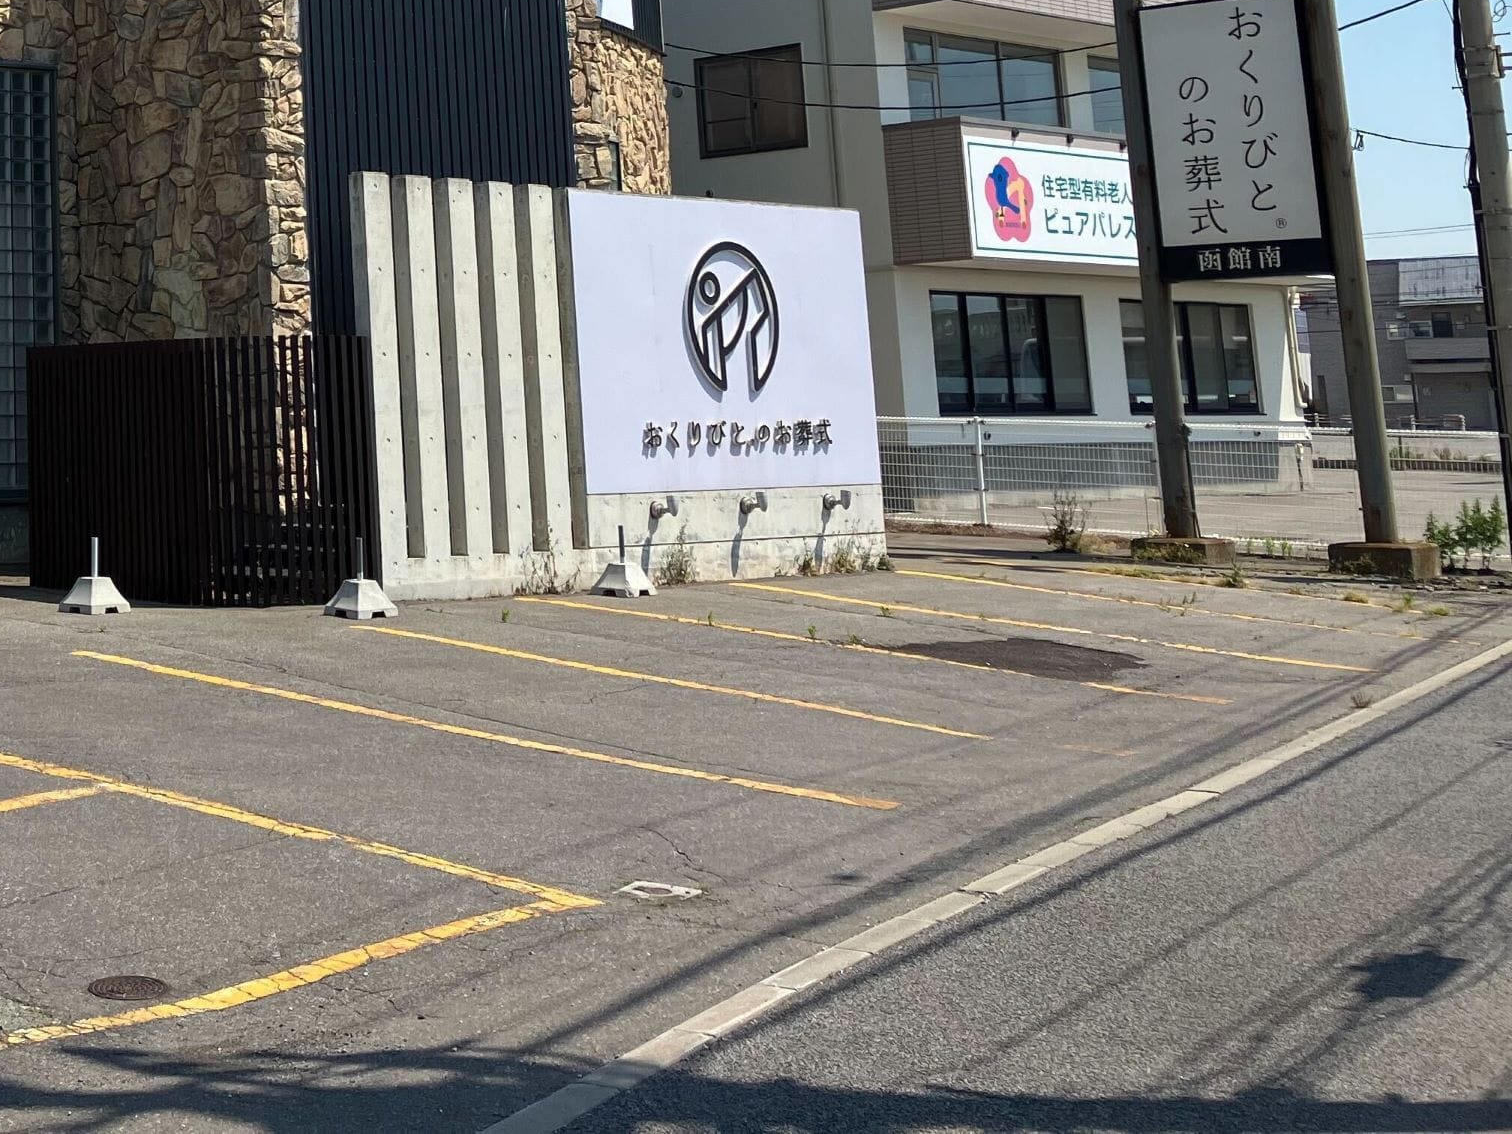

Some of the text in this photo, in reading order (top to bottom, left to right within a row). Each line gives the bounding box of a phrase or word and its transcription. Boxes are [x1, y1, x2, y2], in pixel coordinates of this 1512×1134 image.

[1178, 76, 1228, 235] のお葬式
[1041, 174, 1134, 205] 住宅型有料老人
[1044, 208, 1136, 239] ピュアパレス
[1198, 246, 1281, 272] 函館南
